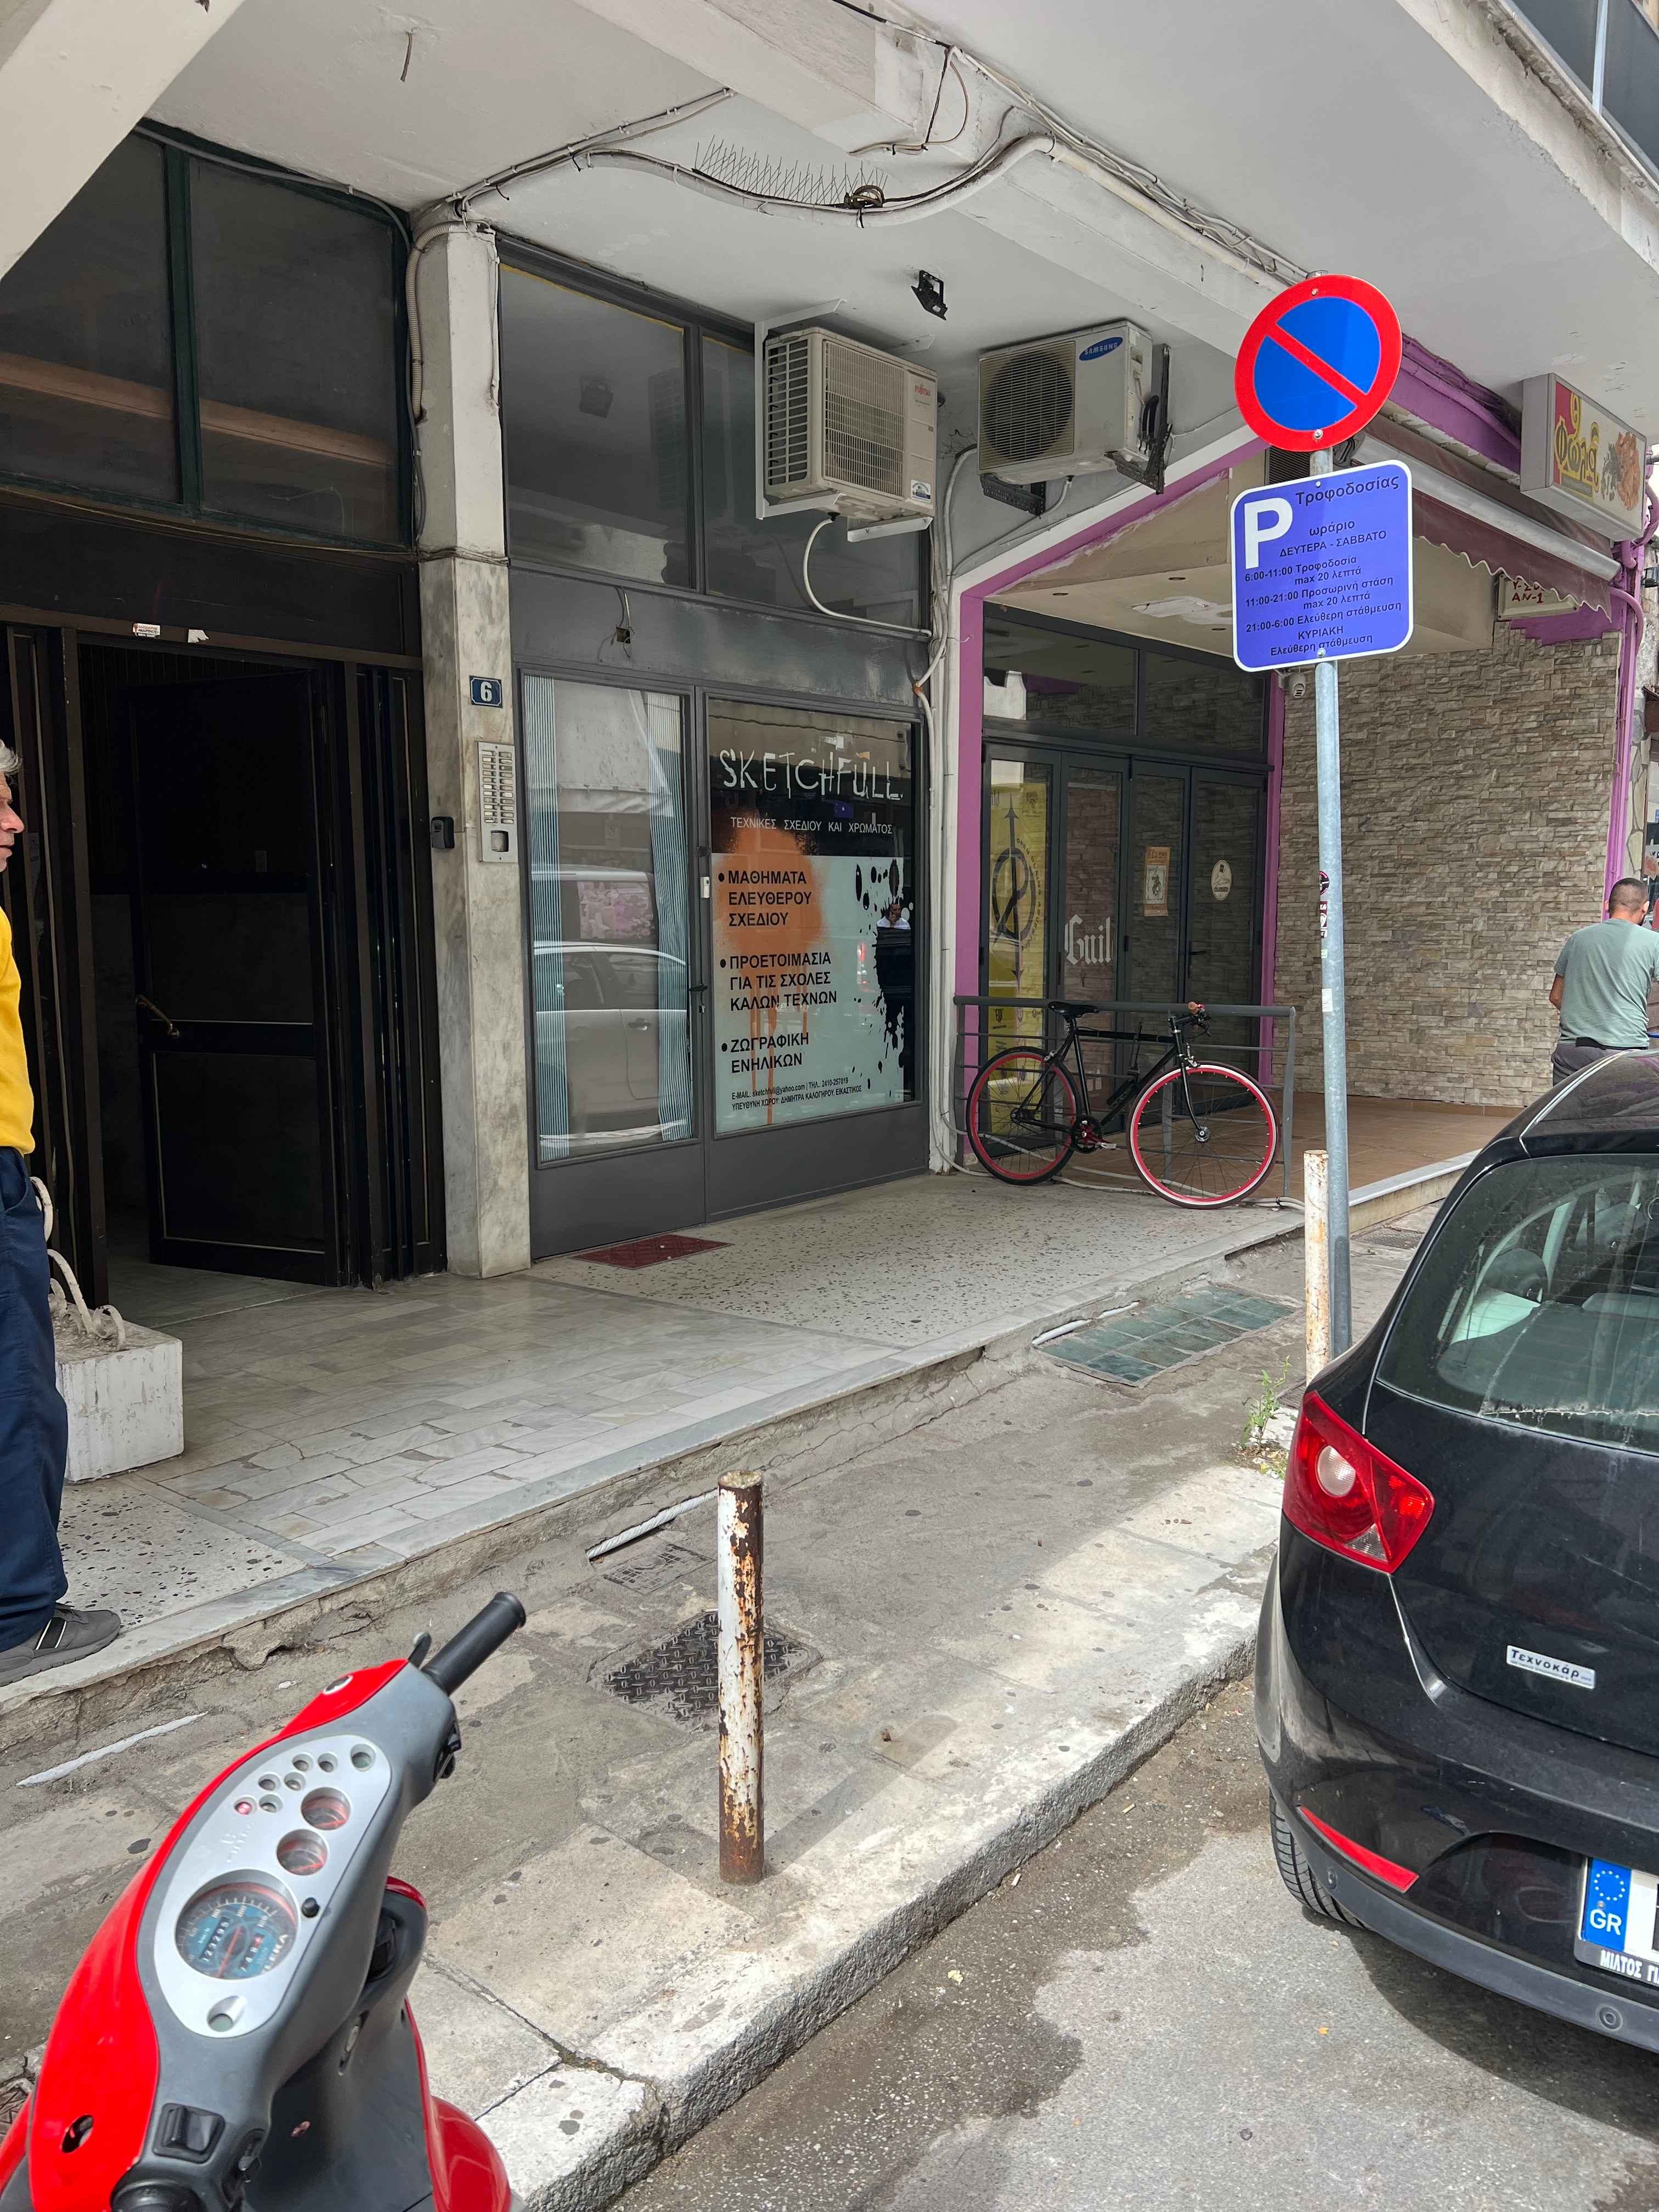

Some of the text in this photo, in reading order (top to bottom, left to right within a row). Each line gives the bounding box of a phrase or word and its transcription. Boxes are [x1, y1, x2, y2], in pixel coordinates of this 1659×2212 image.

[1085, 342, 1118, 355] SAMSUNG
[1295, 476, 1399, 506] Τροφοδοσίας
[1244, 497, 1293, 569] P
[1310, 521, 1355, 536] ωράριο
[1279, 541, 1327, 557] ΔΕΥΤΕΡΑ
[1336, 531, 1386, 547] ΣΑΒΒΑΤΟ
[1245, 556, 1357, 582] 6:00-11:00 Τροφοδοσία
[1295, 566, 1361, 585] max 20 λεπτά
[1245, 576, 1393, 607] 11:00-21:00 Προσωρινή στάση
[1304, 591, 1370, 610] max 20 λεπτά
[1246, 602, 1402, 633] 21:00-6:00 Ελεύθερη στάθμευση
[1298, 626, 1343, 640] ΚΥΡΙΑΚΗ
[1271, 635, 1373, 656] Ελεύθερη στάθμευση
[480, 681, 492, 702] 6
[730, 816, 893, 834] ΤΕΧΝΙΚΕΣ ΣΧΕΔΙΟΥ ΚΑΙ ΧΡΩΜΑΤΟΣ
[728, 870, 807, 884] ΜΑΘΗΜΑΤΑ
[729, 891, 812, 905] ΕΛΕΥΘΕΡΟΥ
[729, 912, 789, 927] ΣΧΕΔΙΟΥ
[730, 952, 832, 969] ΠΡΟΕΤΟΙΜΑΣΙΑ
[730, 972, 831, 990] ΓΙΑ ΤΙΣ ΣΧΟΛΕΣ
[730, 991, 837, 1011] ΚΑΛΩΝ ΤΕΧΝΩΝ
[730, 1032, 809, 1053] ΖΩΓΡΑΦΙΚΗ
[732, 1052, 802, 1074] ΕΝΗΛΙΚΩΝ
[822, 1077, 848, 1087] 2410-257019
[732, 1099, 760, 1110] ΥΠΕΥΘΥΝΗ
[781, 1093, 804, 1103] ΔΗΜΗΤΡΑ
[836, 1085, 862, 1096] ΕΙΚΑΣΤΙΚΟΣ
[1511, 1649, 1579, 1678] Τεχνοκάρ
[1590, 1909, 1622, 1936] GR
[1600, 1949, 1643, 1978] ΜΙΛΤΟΣ
